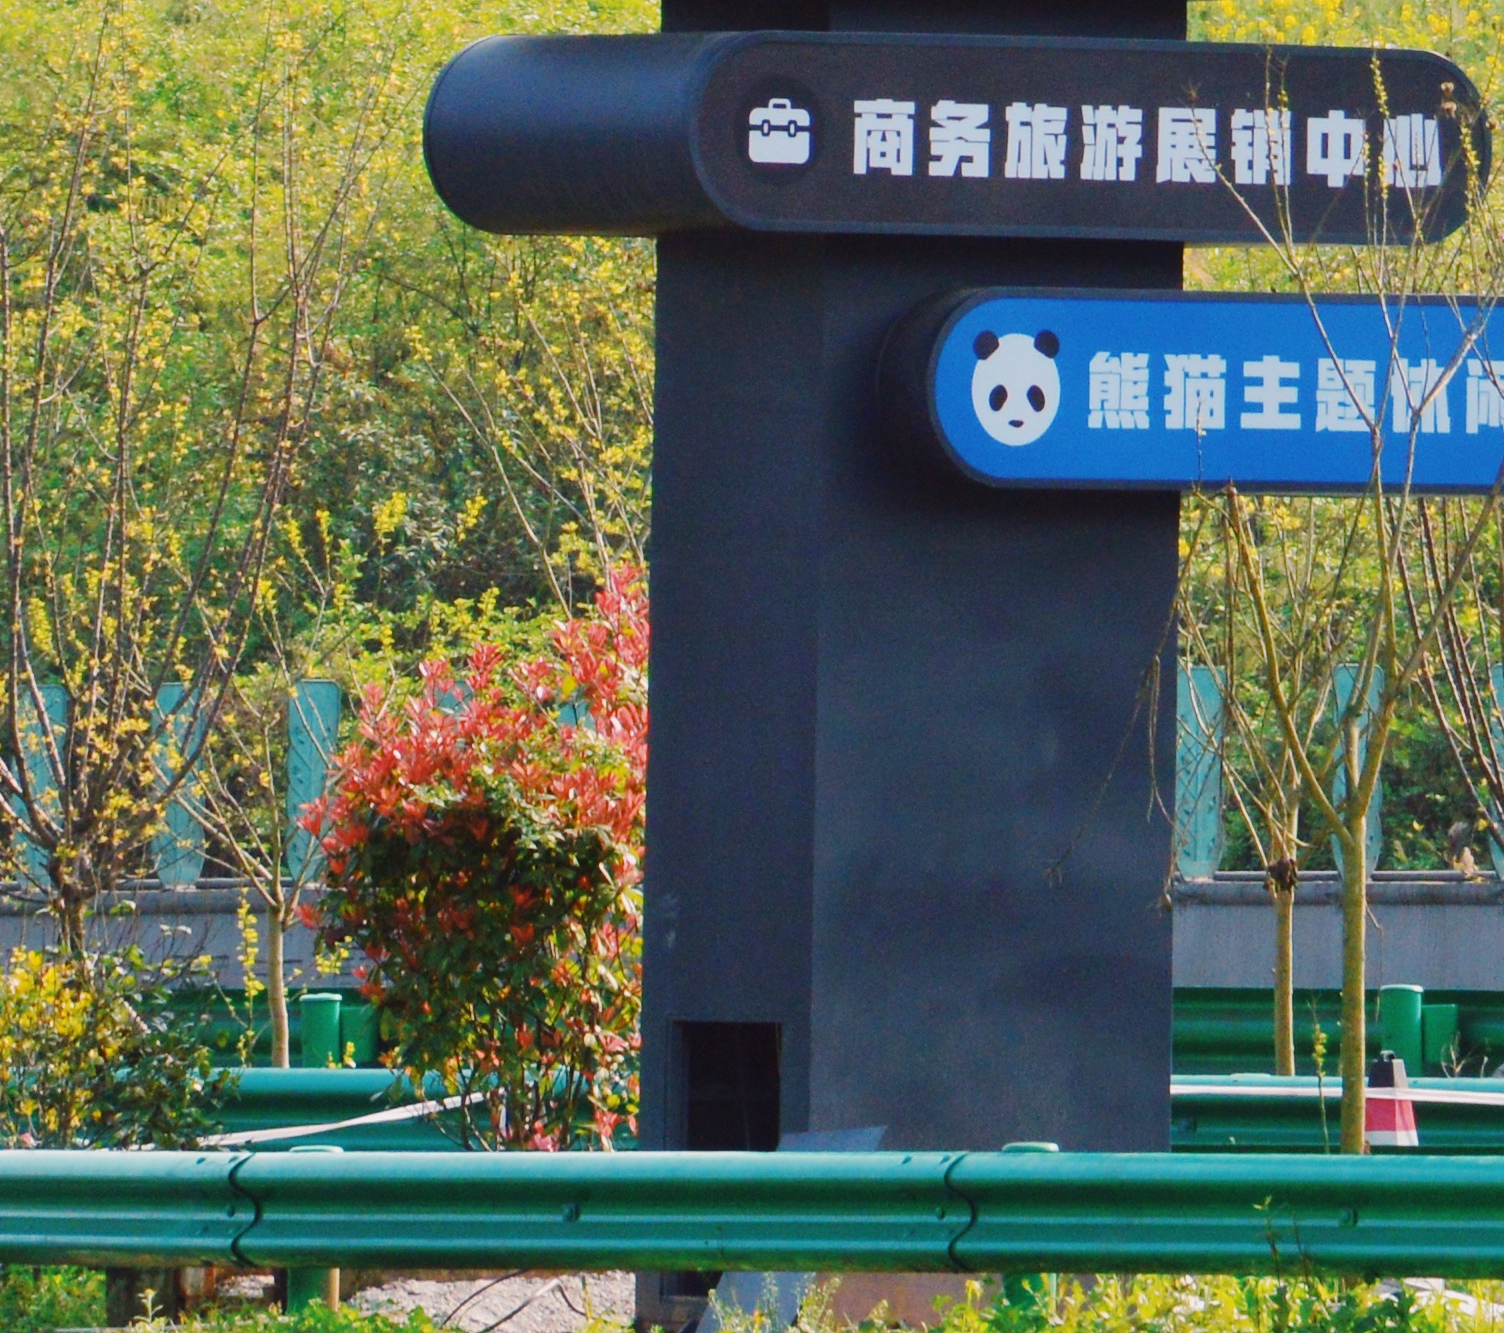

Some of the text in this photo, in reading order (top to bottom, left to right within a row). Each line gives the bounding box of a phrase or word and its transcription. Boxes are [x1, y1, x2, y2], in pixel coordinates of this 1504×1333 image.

[853, 98, 1442, 188] 商务旅游展销中心
